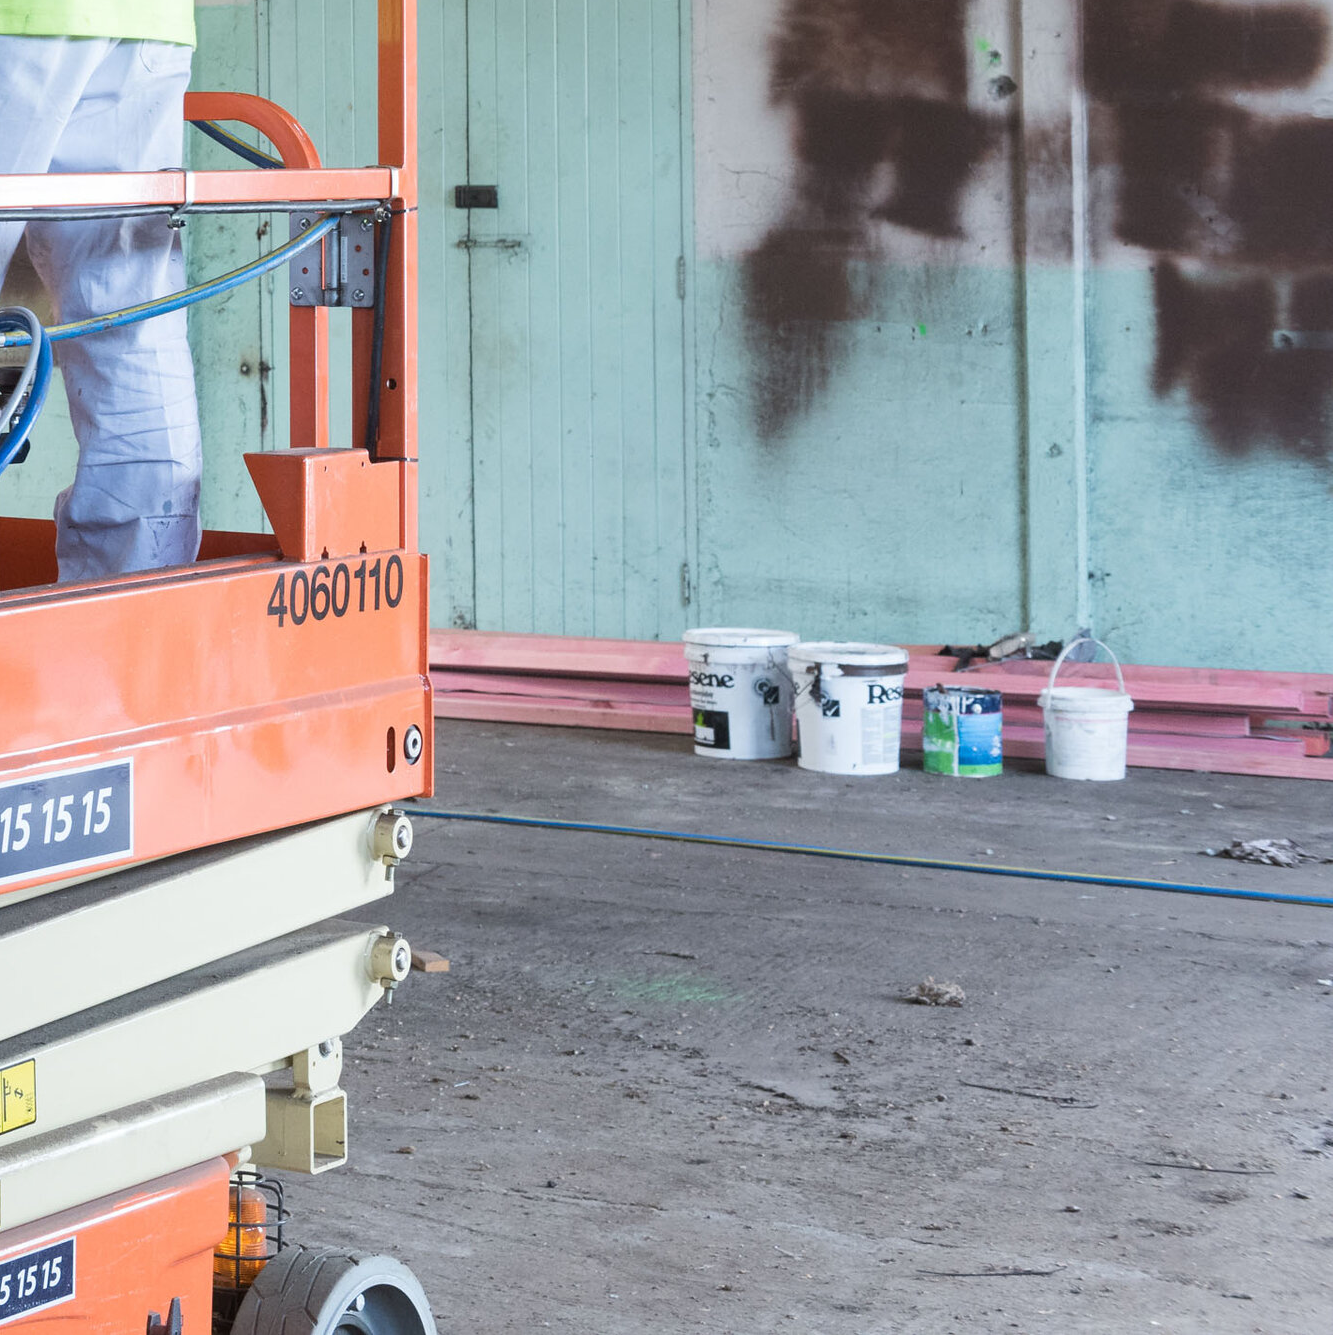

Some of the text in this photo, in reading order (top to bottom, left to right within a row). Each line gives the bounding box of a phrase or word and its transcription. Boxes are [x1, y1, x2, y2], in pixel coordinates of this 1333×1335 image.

[267, 554, 404, 628] 4060110
[689, 670, 735, 689] sene
[867, 684, 903, 704] Res
[0, 802, 31, 854] 15
[42, 794, 75, 845] 15
[82, 786, 113, 836] 15
[16, 1264, 38, 1299] 15
[41, 1255, 63, 1290] 15
